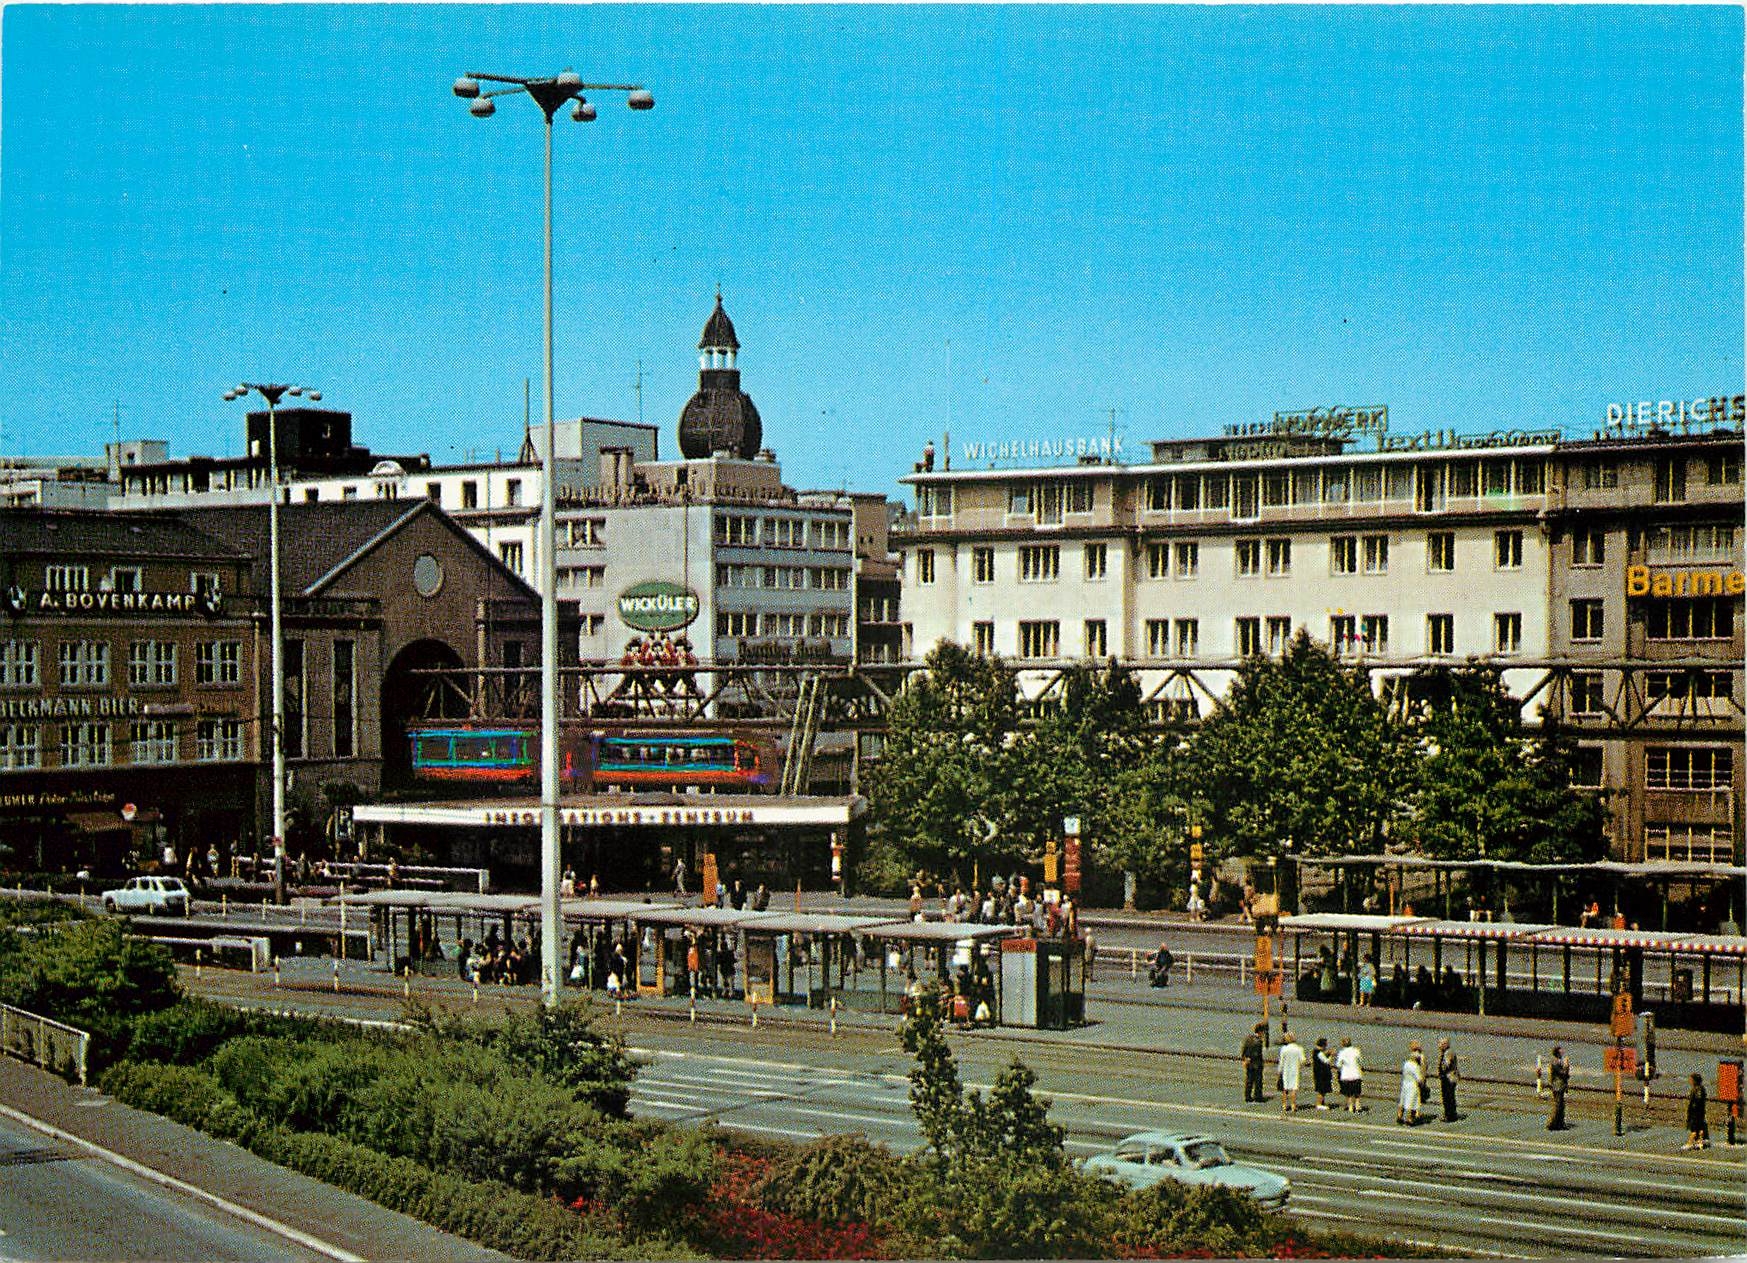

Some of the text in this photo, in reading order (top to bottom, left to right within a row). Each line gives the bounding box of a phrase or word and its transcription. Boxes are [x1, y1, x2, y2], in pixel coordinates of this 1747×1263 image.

[963, 434, 1124, 460] WICHELHAUSBANK
[1627, 565, 1745, 598] Barme
[40, 592, 196, 609] A. BOVENKAMP
[620, 593, 697, 612] WICKÜLER
[661, 810, 754, 824] ZENTRUM
